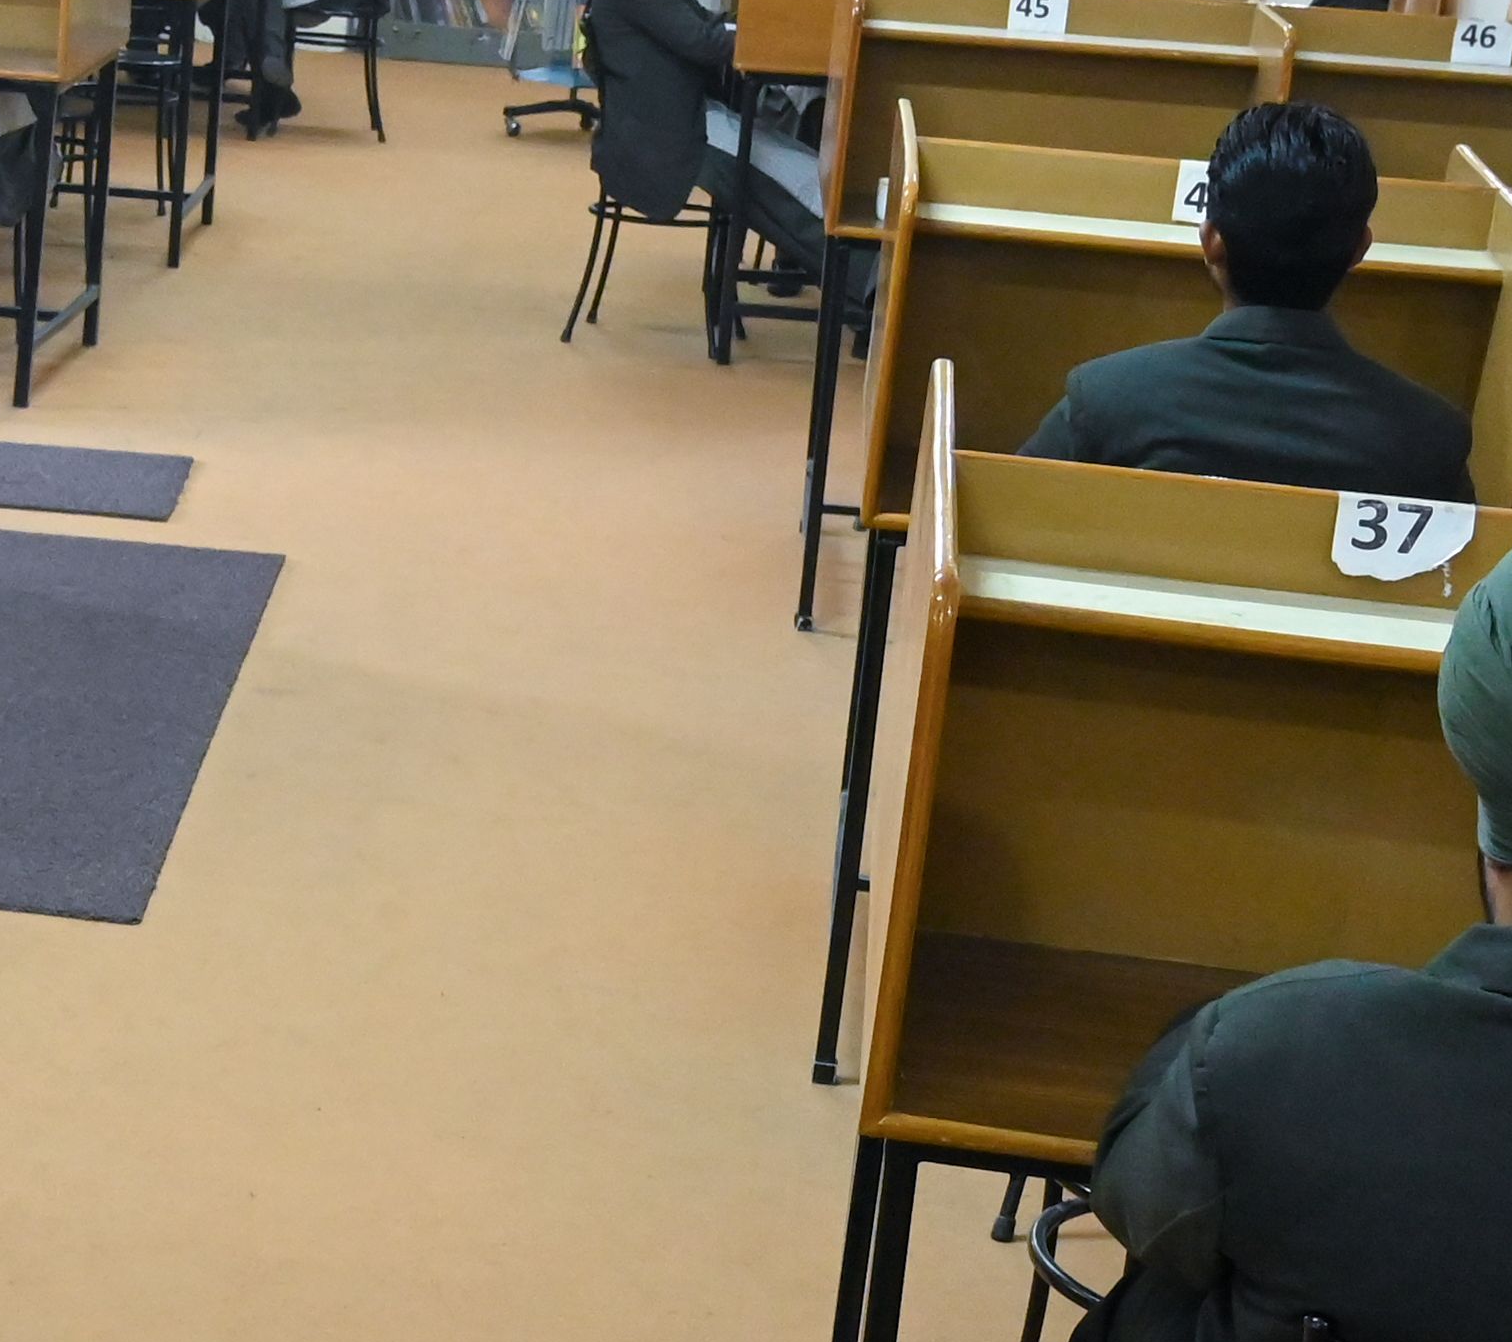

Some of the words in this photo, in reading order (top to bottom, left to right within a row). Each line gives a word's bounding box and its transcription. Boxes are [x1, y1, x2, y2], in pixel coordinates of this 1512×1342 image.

[1460, 24, 1496, 49] 46
[1184, 181, 1208, 213] 4
[1351, 499, 1434, 554] 37
